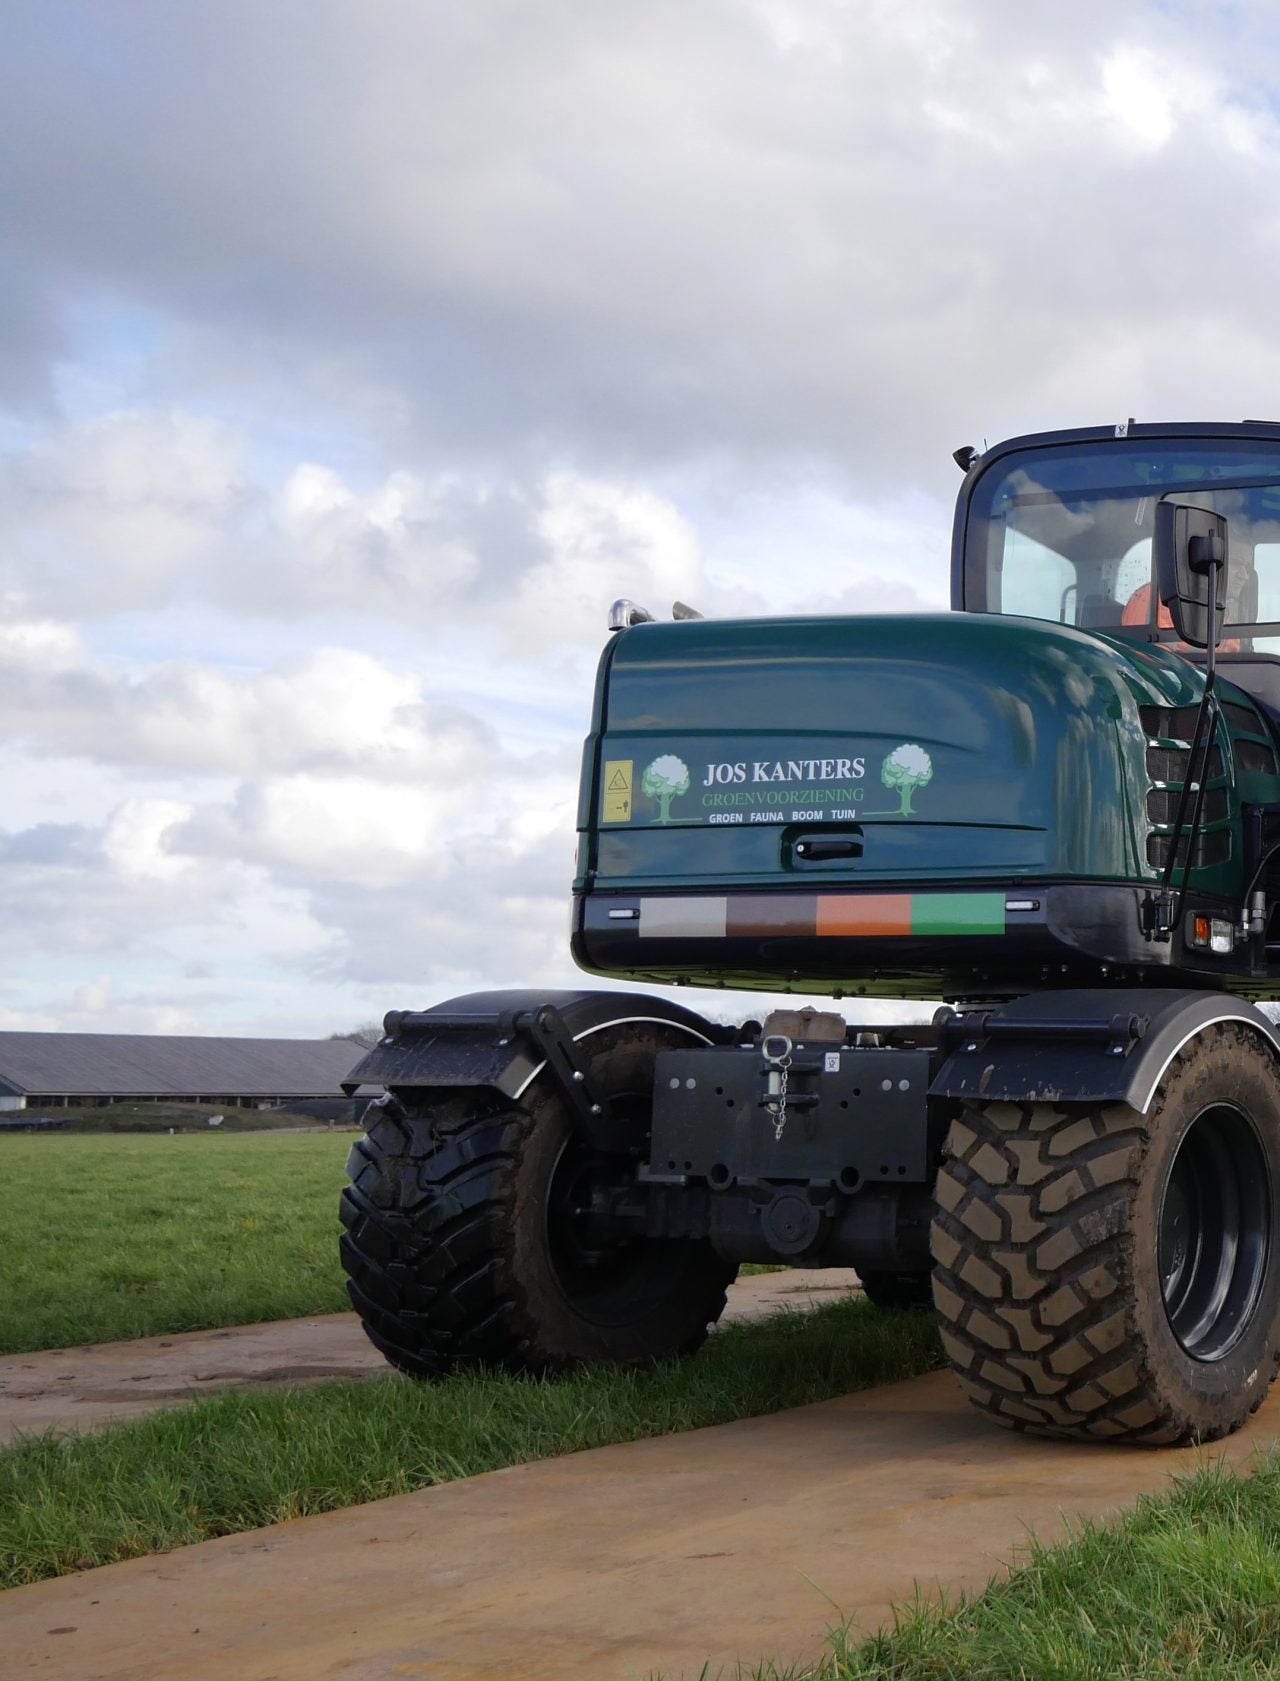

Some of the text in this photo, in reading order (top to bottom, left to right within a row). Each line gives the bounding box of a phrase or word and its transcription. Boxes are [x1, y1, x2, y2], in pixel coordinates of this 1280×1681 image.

[703, 758, 865, 786] JOS KANTERS
[702, 788, 864, 806] GROENVOORZIENING
[709, 809, 856, 823] GROEN FAUNA BOOM TUIN
